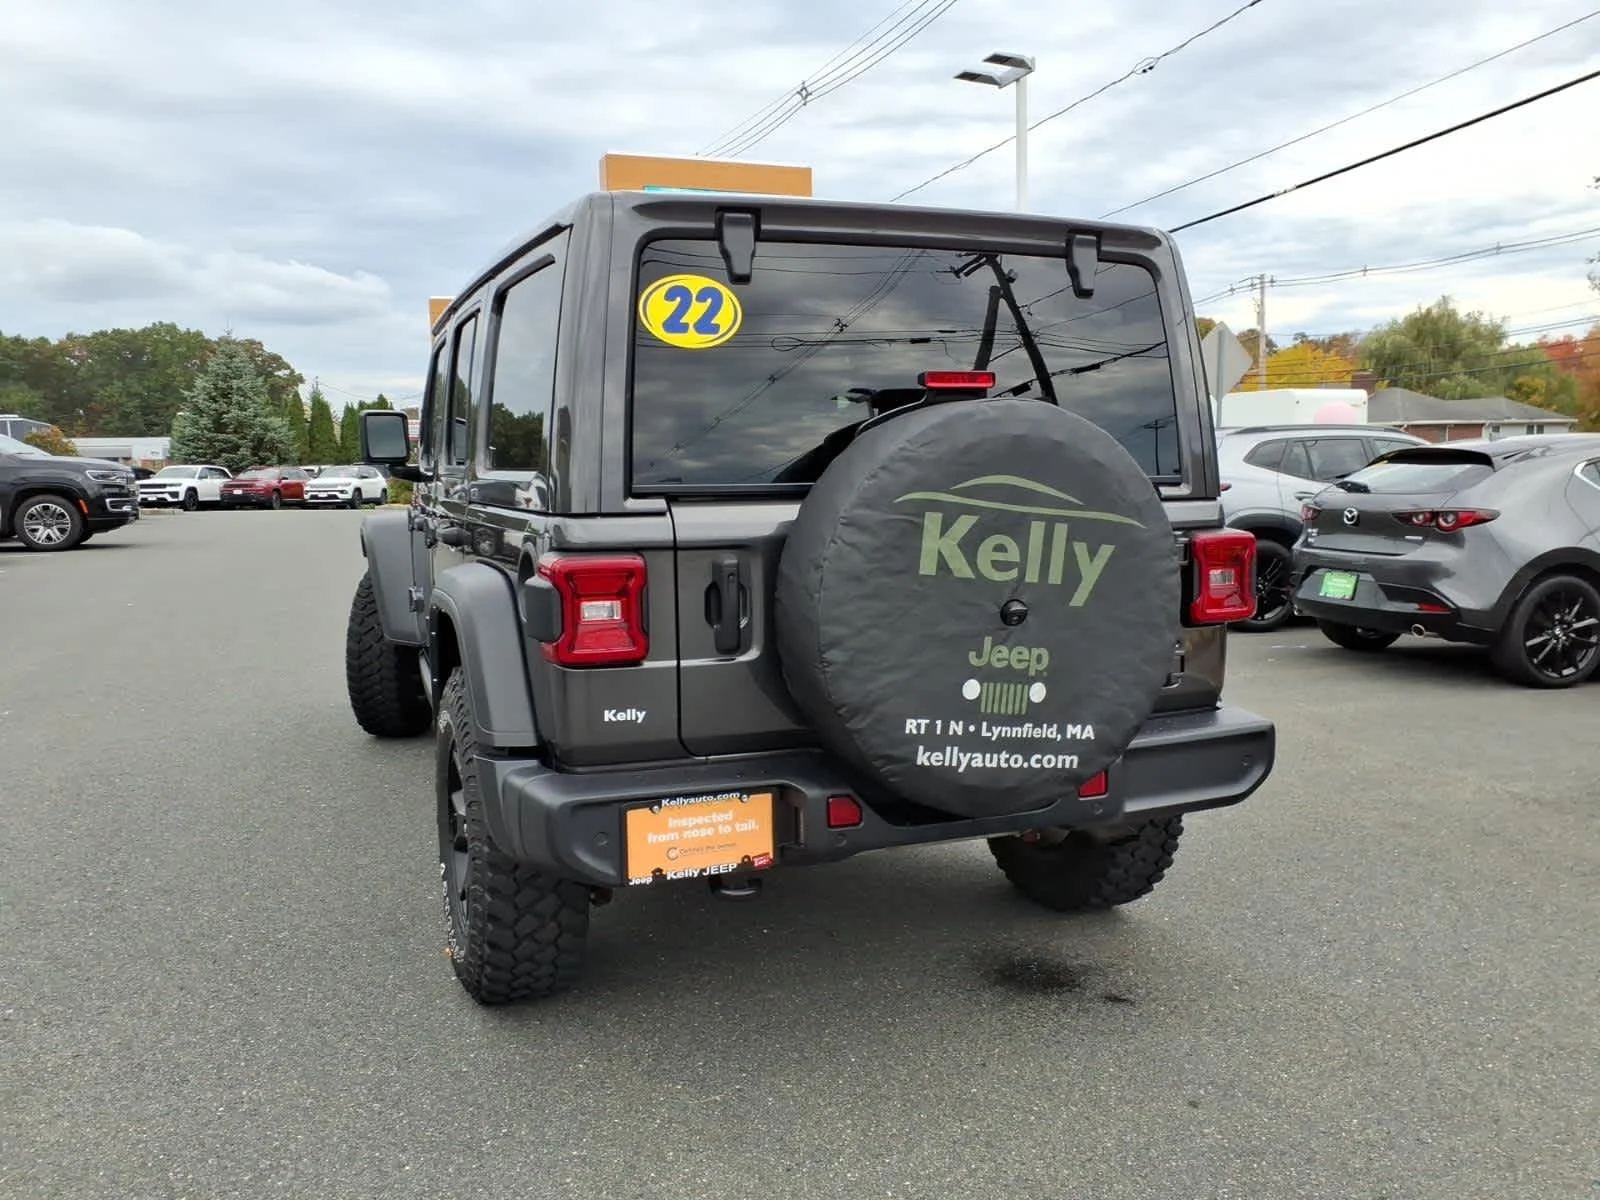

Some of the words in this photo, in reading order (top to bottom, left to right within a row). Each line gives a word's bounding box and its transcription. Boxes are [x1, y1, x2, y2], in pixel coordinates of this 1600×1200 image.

[662, 285, 724, 335] 22
[919, 511, 1116, 607] Kelly
[968, 636, 1049, 676] Jeep
[603, 708, 647, 724] Kelly
[905, 718, 930, 735] RT
[935, 719, 942, 735] 1
[949, 720, 964, 737] N
[981, 721, 1062, 742] Lynnfield,
[1066, 723, 1095, 741] MA
[916, 745, 1079, 773] kellyauto.com
[661, 791, 741, 810] Kellyauto.com
[667, 810, 733, 829] Inspected
[647, 831, 680, 845] from
[683, 825, 715, 840] nose
[718, 821, 732, 836] to
[629, 874, 654, 887] Jeep
[666, 866, 701, 881] Kelly
[702, 862, 738, 877] JEEP
